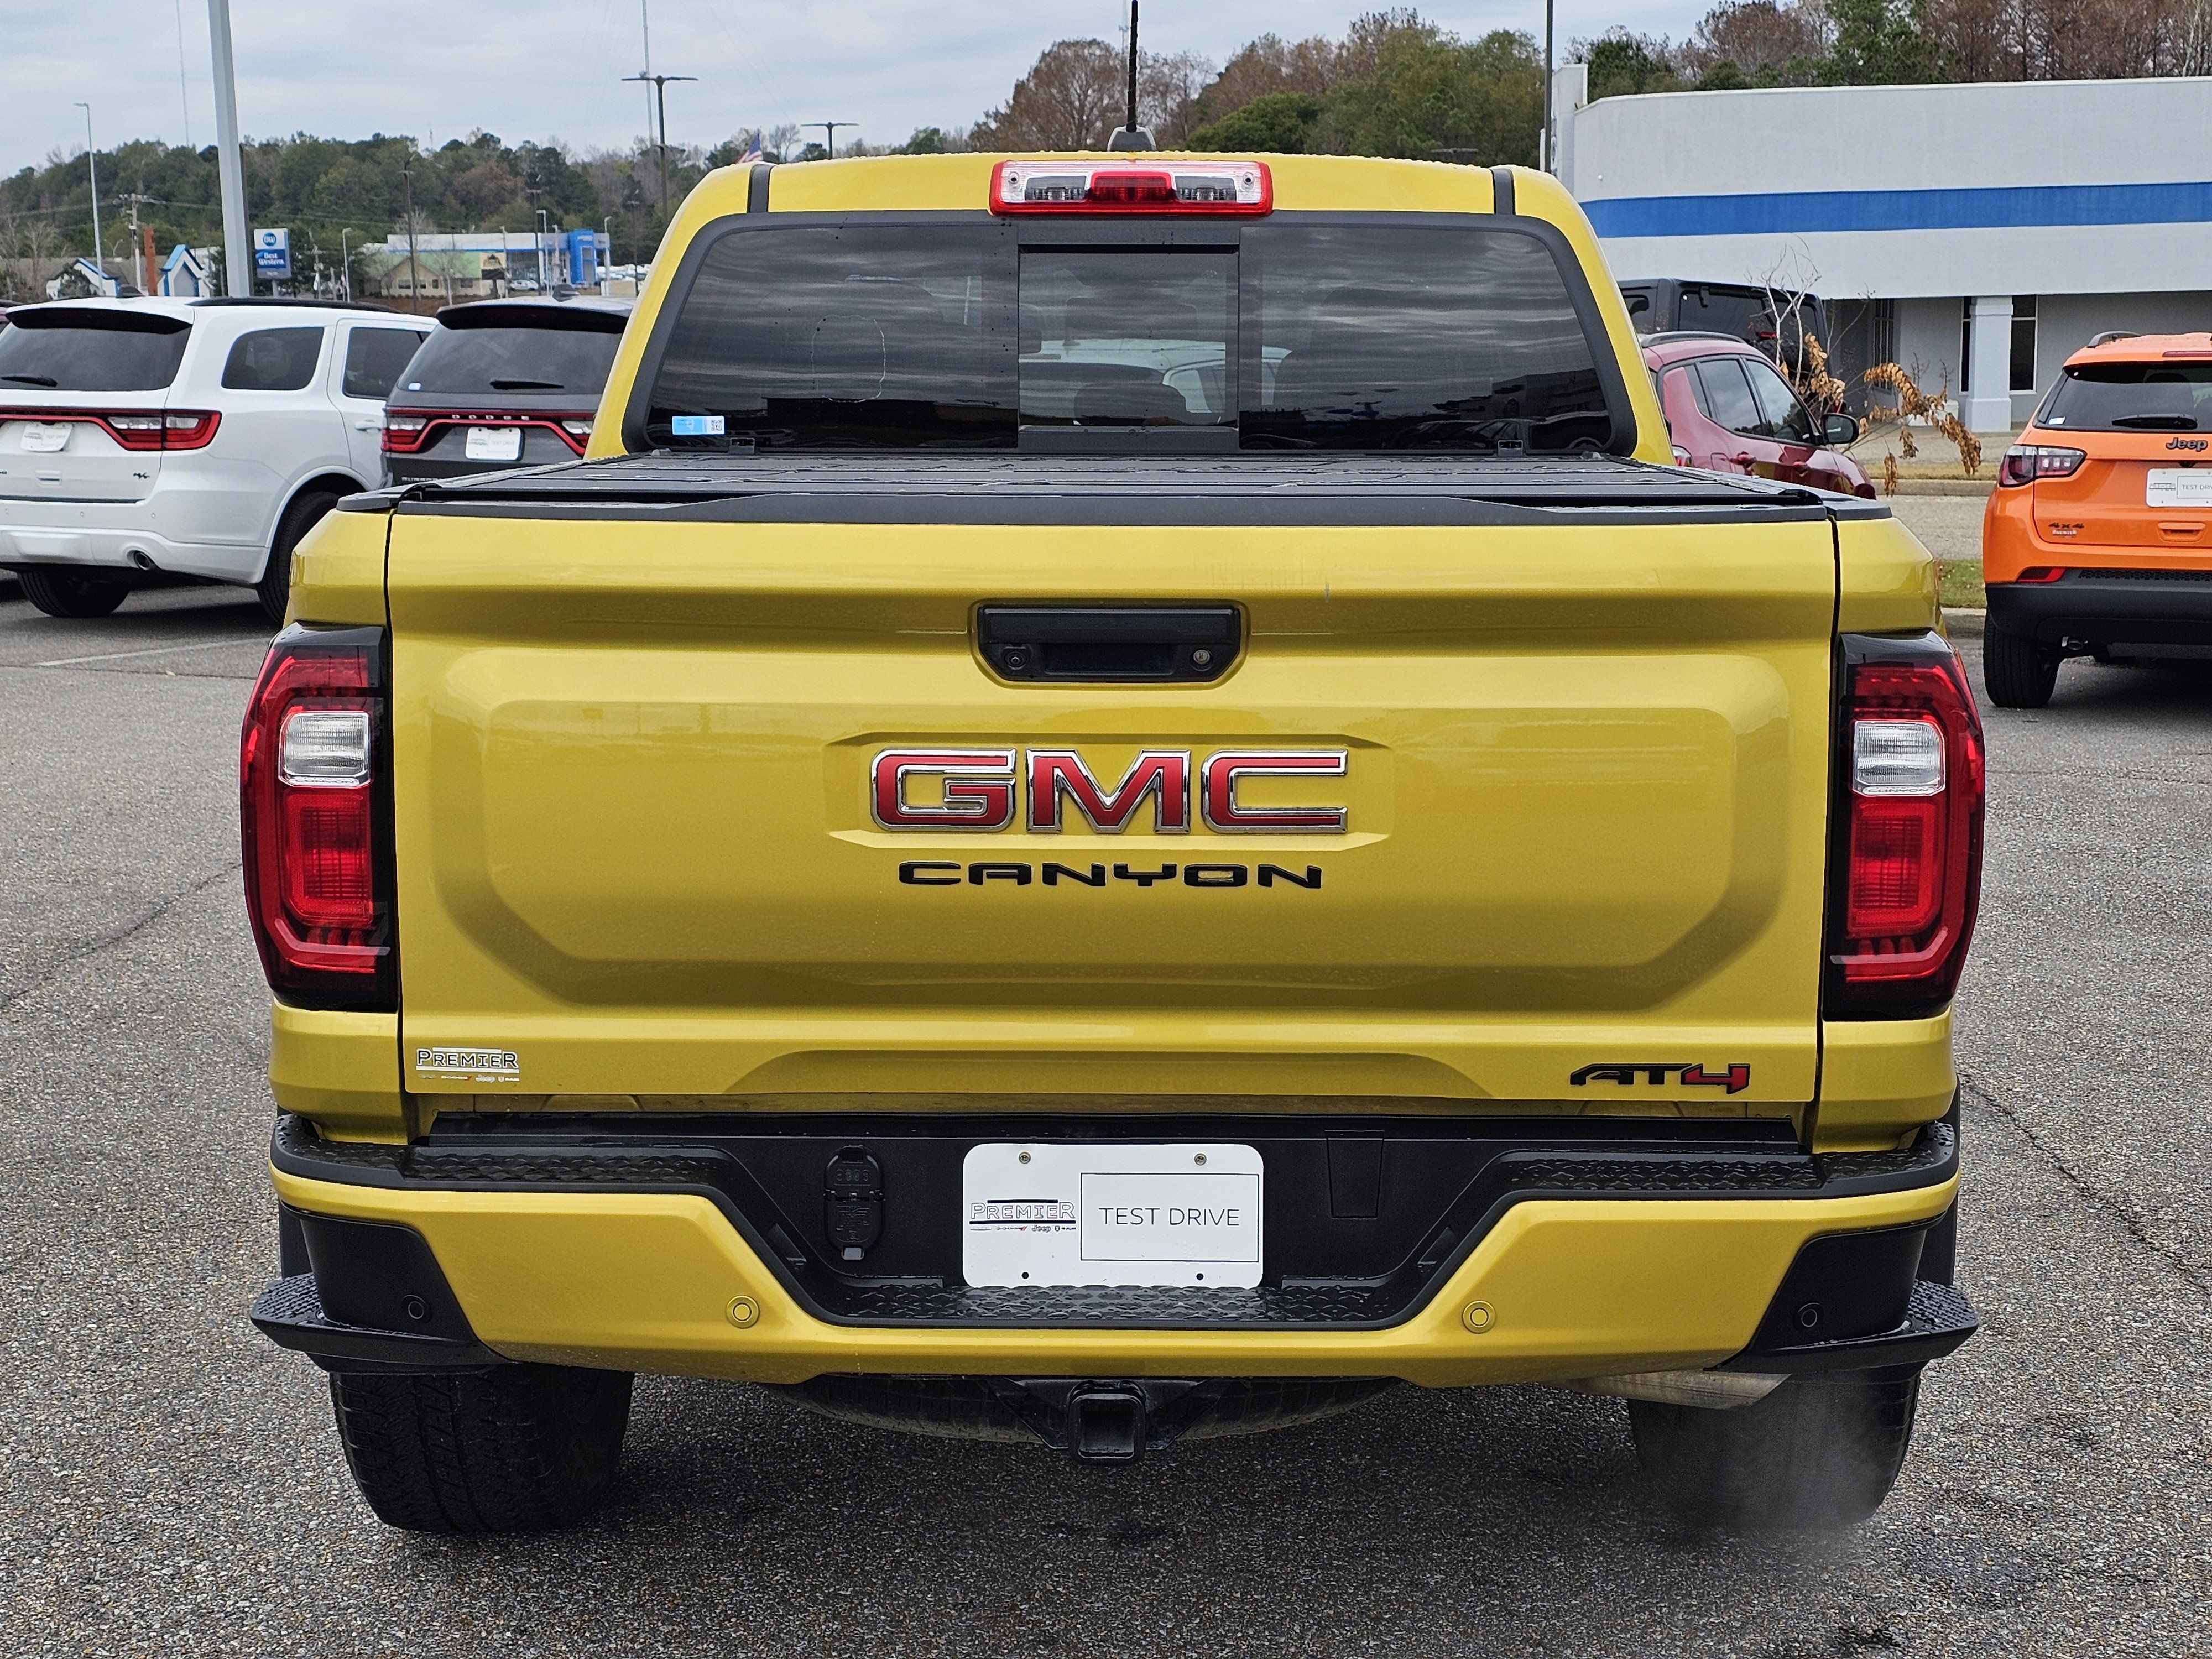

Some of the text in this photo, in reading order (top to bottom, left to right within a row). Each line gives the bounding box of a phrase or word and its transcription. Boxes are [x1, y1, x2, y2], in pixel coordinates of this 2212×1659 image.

[2166, 437, 2208, 452] Jeep
[870, 748, 1348, 834] GMC
[899, 860, 1322, 889] CANYON
[416, 1048, 519, 1069] PREMIER
[1569, 1062, 1751, 1095] AT4
[971, 1202, 1240, 1227] PREMIER TEST DRIVE
